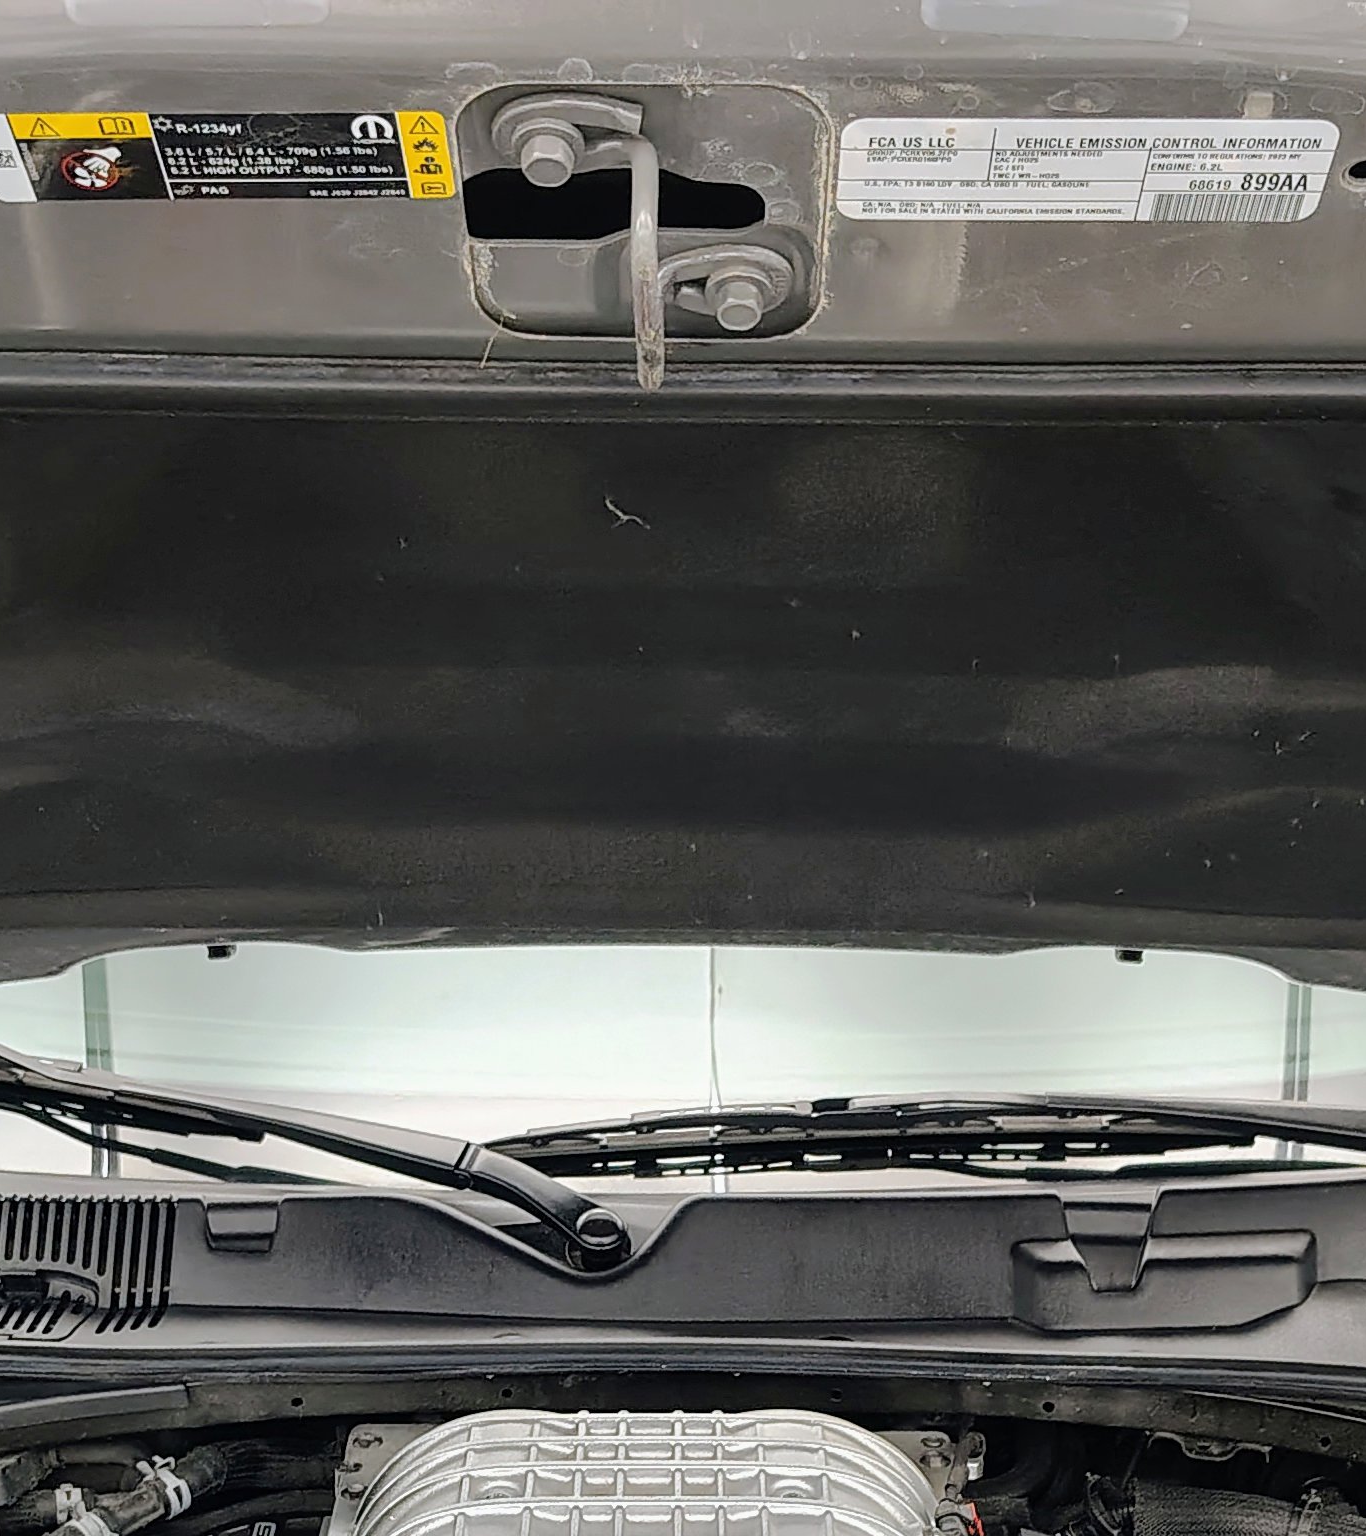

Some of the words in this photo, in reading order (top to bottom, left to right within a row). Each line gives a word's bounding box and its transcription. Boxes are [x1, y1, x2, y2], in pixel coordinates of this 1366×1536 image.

[868, 137, 897, 148] FCA
[902, 137, 923, 148] US
[928, 137, 956, 148] LLC
[1016, 137, 1075, 149] VEHICLE
[1079, 137, 1148, 149] EMISSION
[1152, 137, 1218, 149] CONTROL
[1222, 138, 1323, 149] INFORMATION
[238, 165, 292, 175] OUTPUT
[1150, 163, 1196, 171] ENGINE:
[1199, 163, 1223, 171] 6.2L
[1189, 179, 1232, 191] 68619
[1240, 173, 1308, 191] 899AA
[200, 186, 230, 195] PAG
